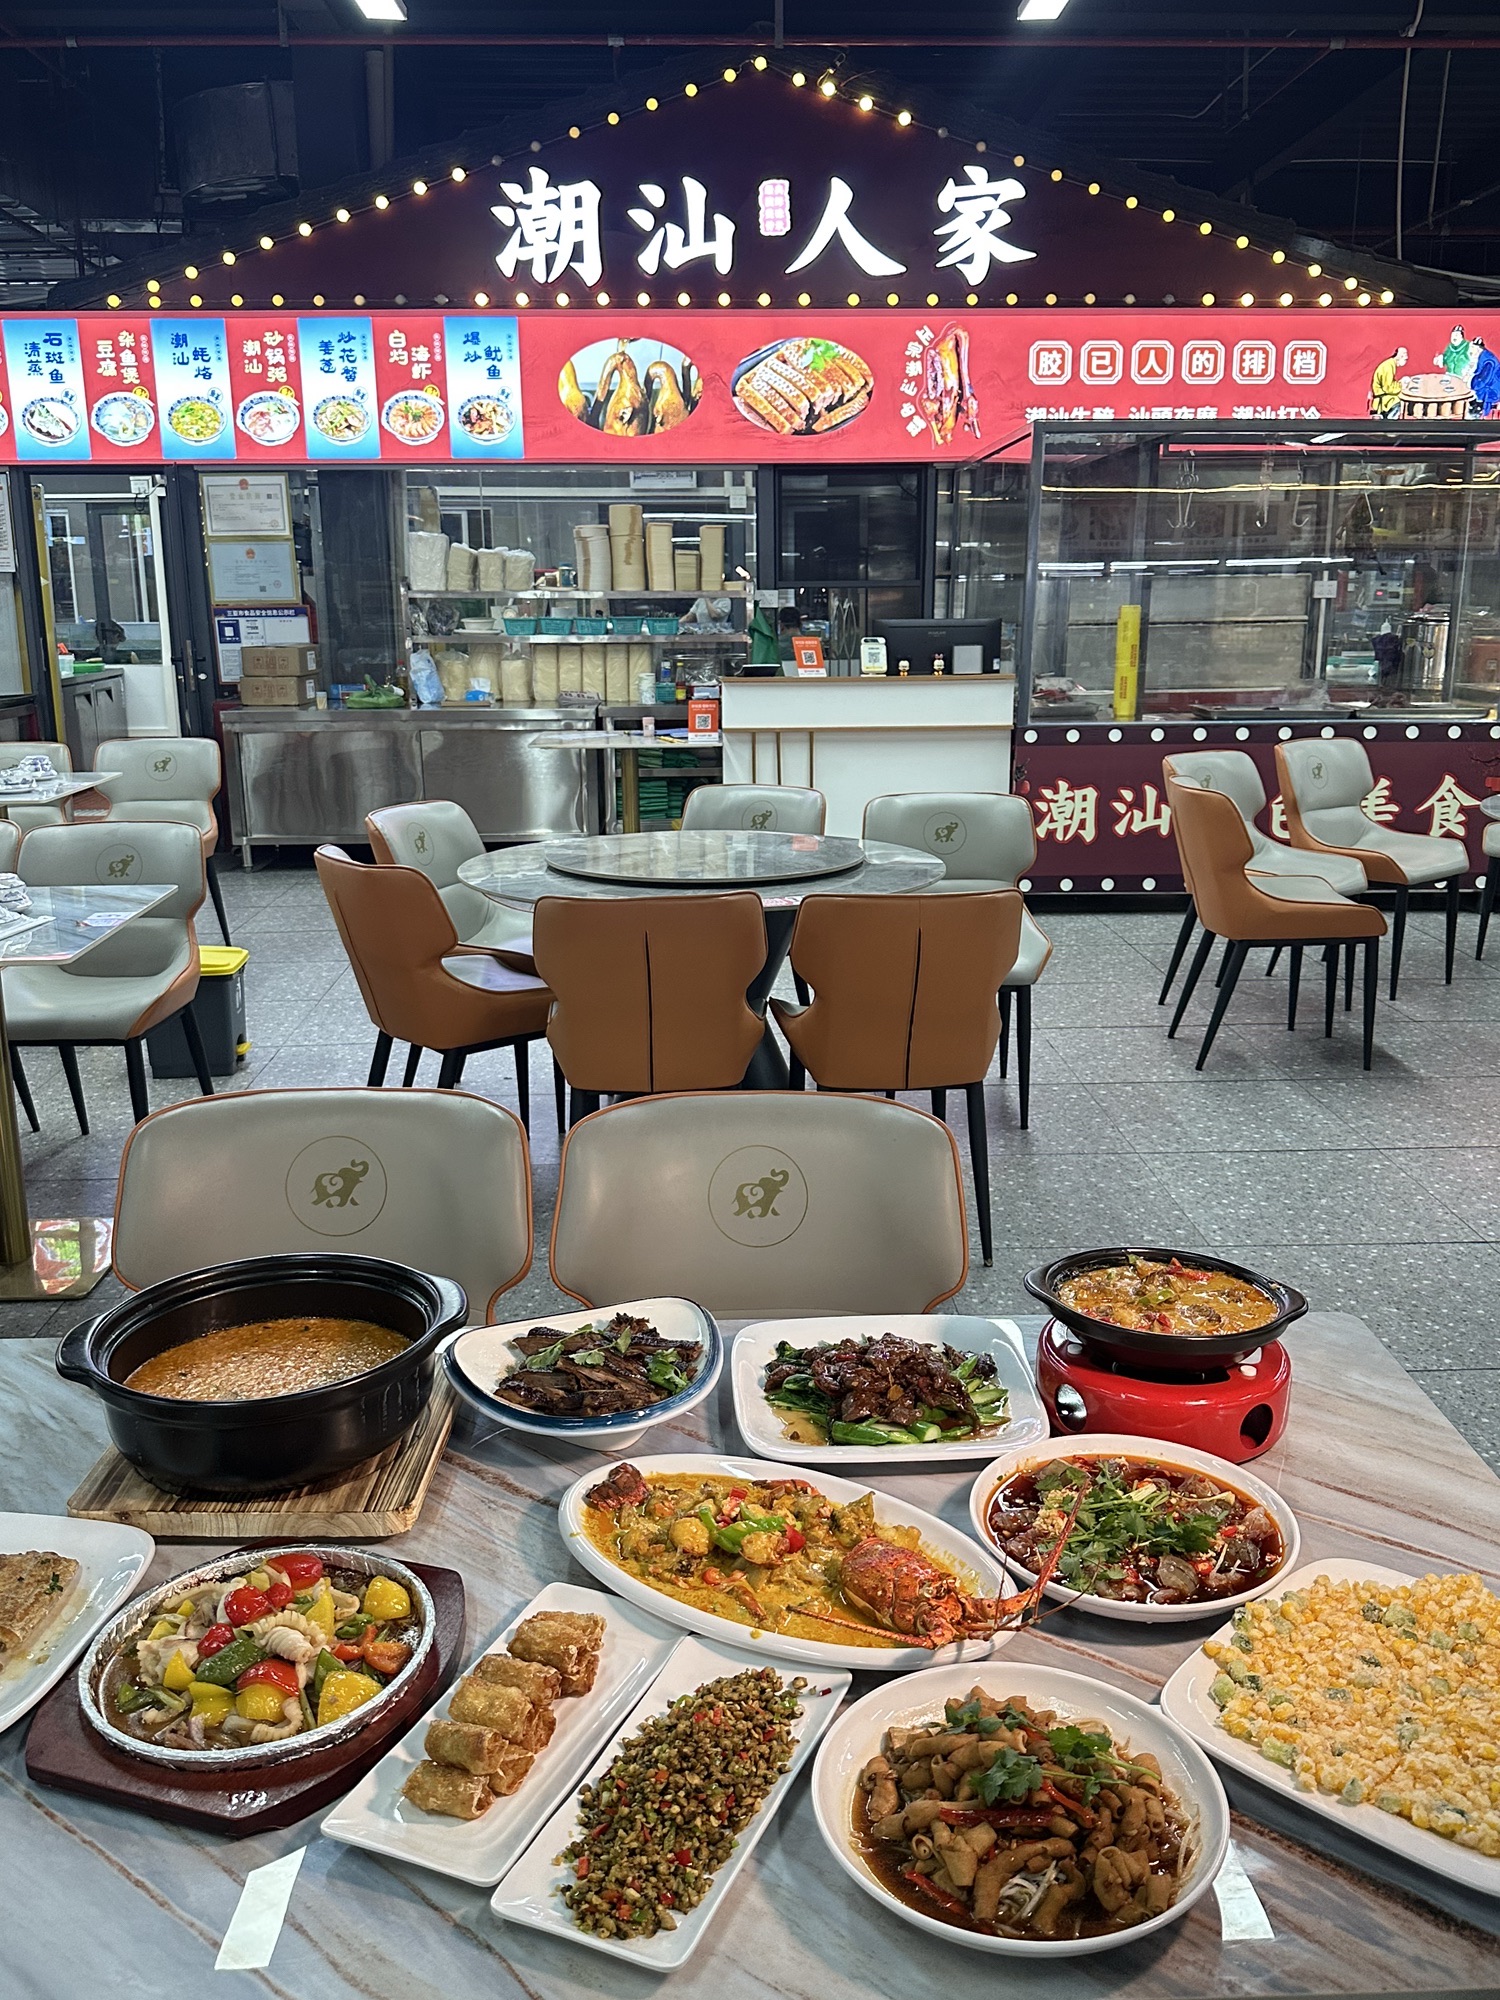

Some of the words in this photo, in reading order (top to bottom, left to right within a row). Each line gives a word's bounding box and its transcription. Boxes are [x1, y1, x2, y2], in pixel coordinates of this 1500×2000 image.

[490, 165, 1038, 288] 潮汕人家
[24, 341, 44, 376] 清蒸
[42, 332, 66, 384] 石斑鱼
[96, 339, 118, 377] 豆腐
[117, 329, 141, 385] 杂鱼煲
[170, 331, 190, 366] 潮汕
[192, 346, 213, 380] 蚝烙
[242, 339, 263, 374] 潮汕
[262, 329, 288, 383] 砂锅粥
[318, 339, 337, 374] 姜葱
[337, 330, 358, 382] 炒花蟹
[388, 328, 409, 366] 白灼
[410, 344, 433, 380] 海虾
[462, 331, 483, 363] 爆炒
[483, 345, 503, 379] 鱿鱼
